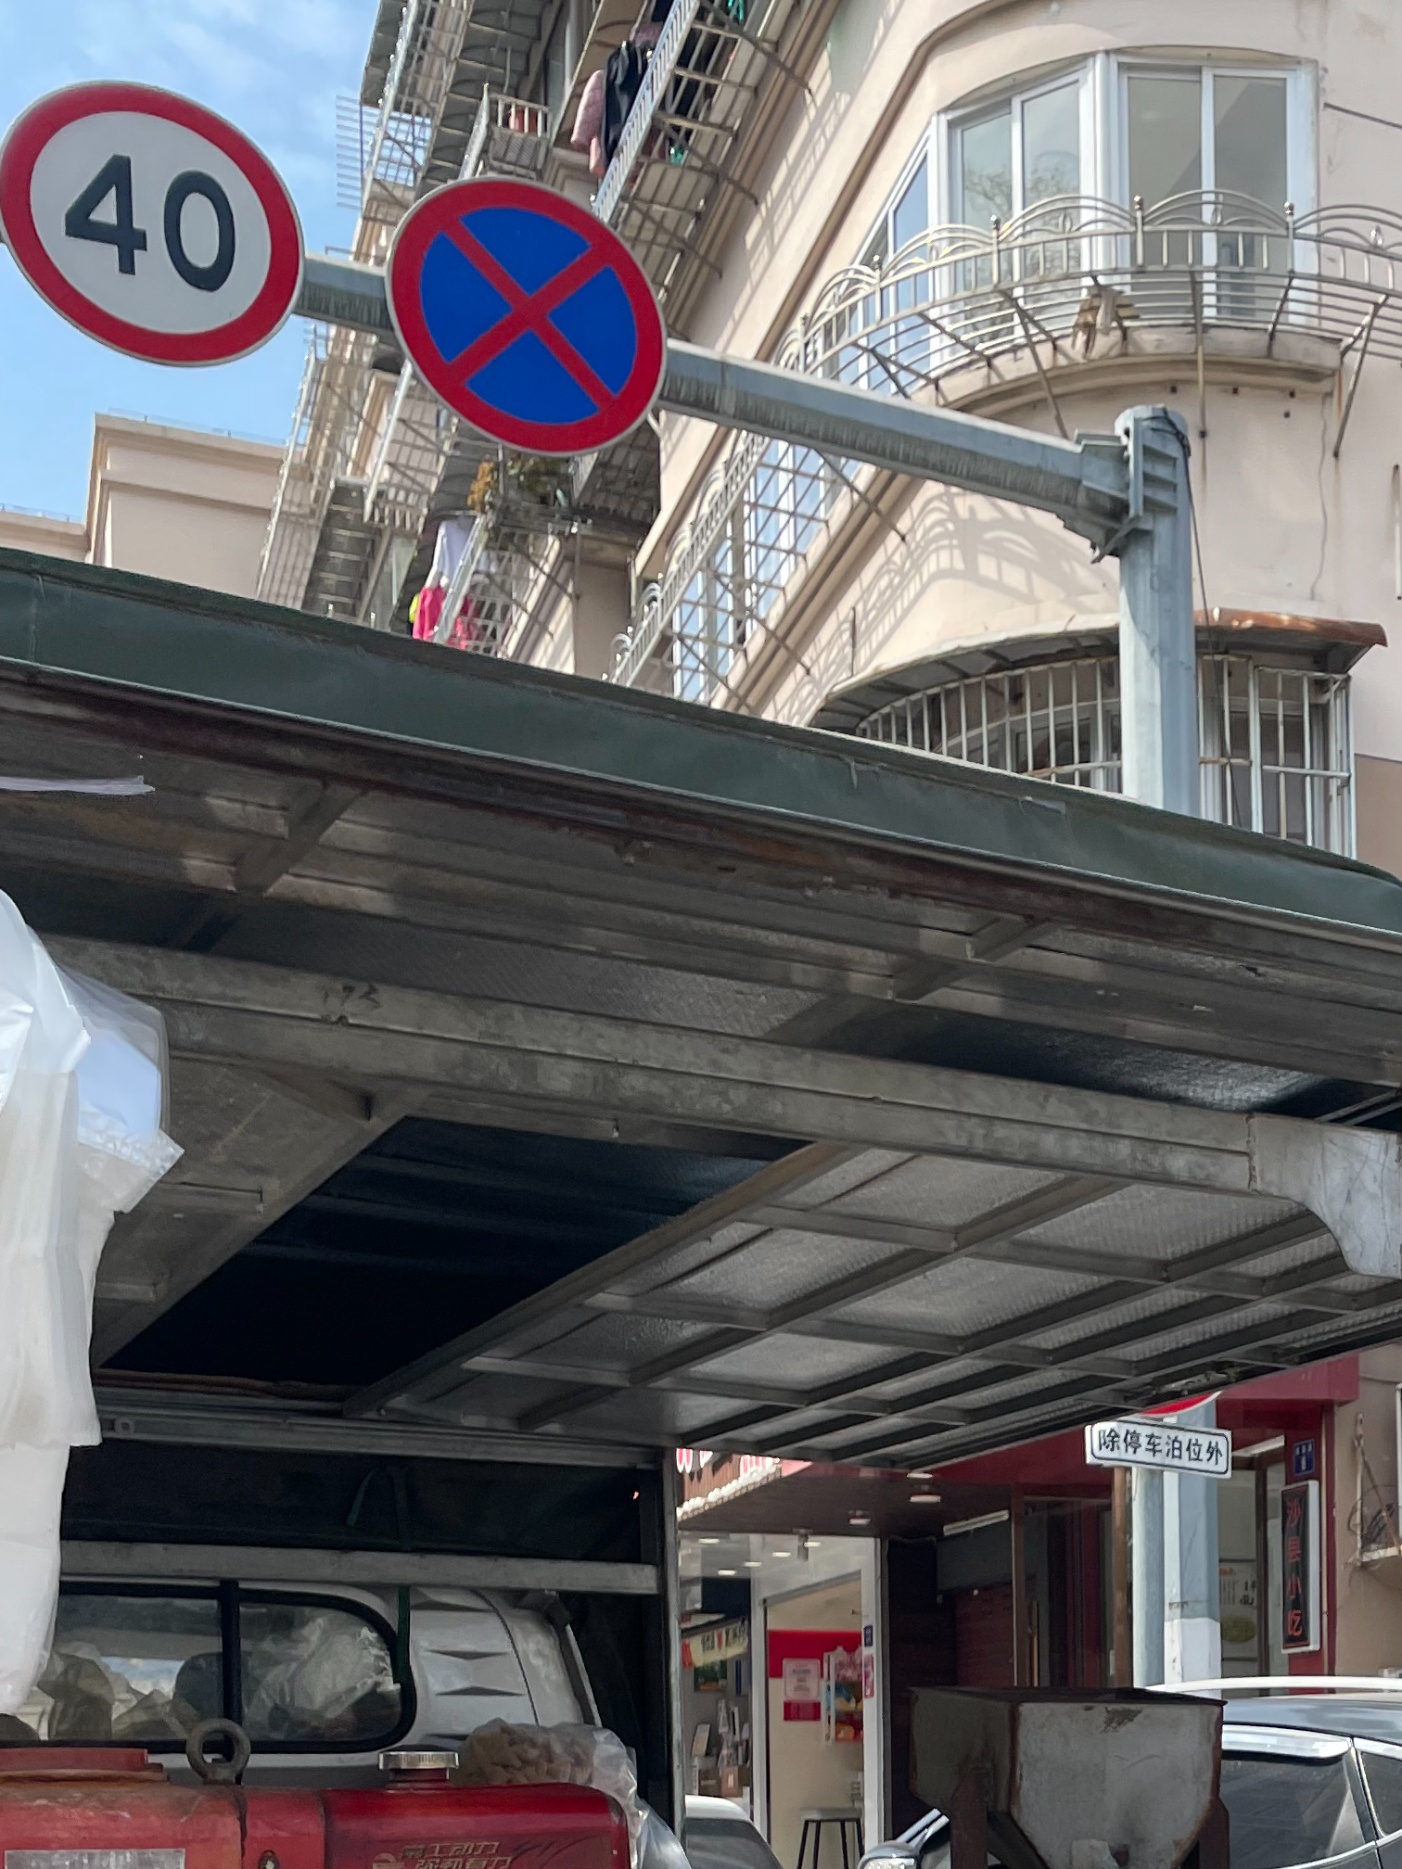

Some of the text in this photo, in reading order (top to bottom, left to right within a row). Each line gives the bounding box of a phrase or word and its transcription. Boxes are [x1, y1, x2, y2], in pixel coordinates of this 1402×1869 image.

[65, 154, 236, 293] 40
[1098, 1427, 1223, 1465] 除停车泊位外
[1286, 1500, 1303, 1636] 沙县小吃
